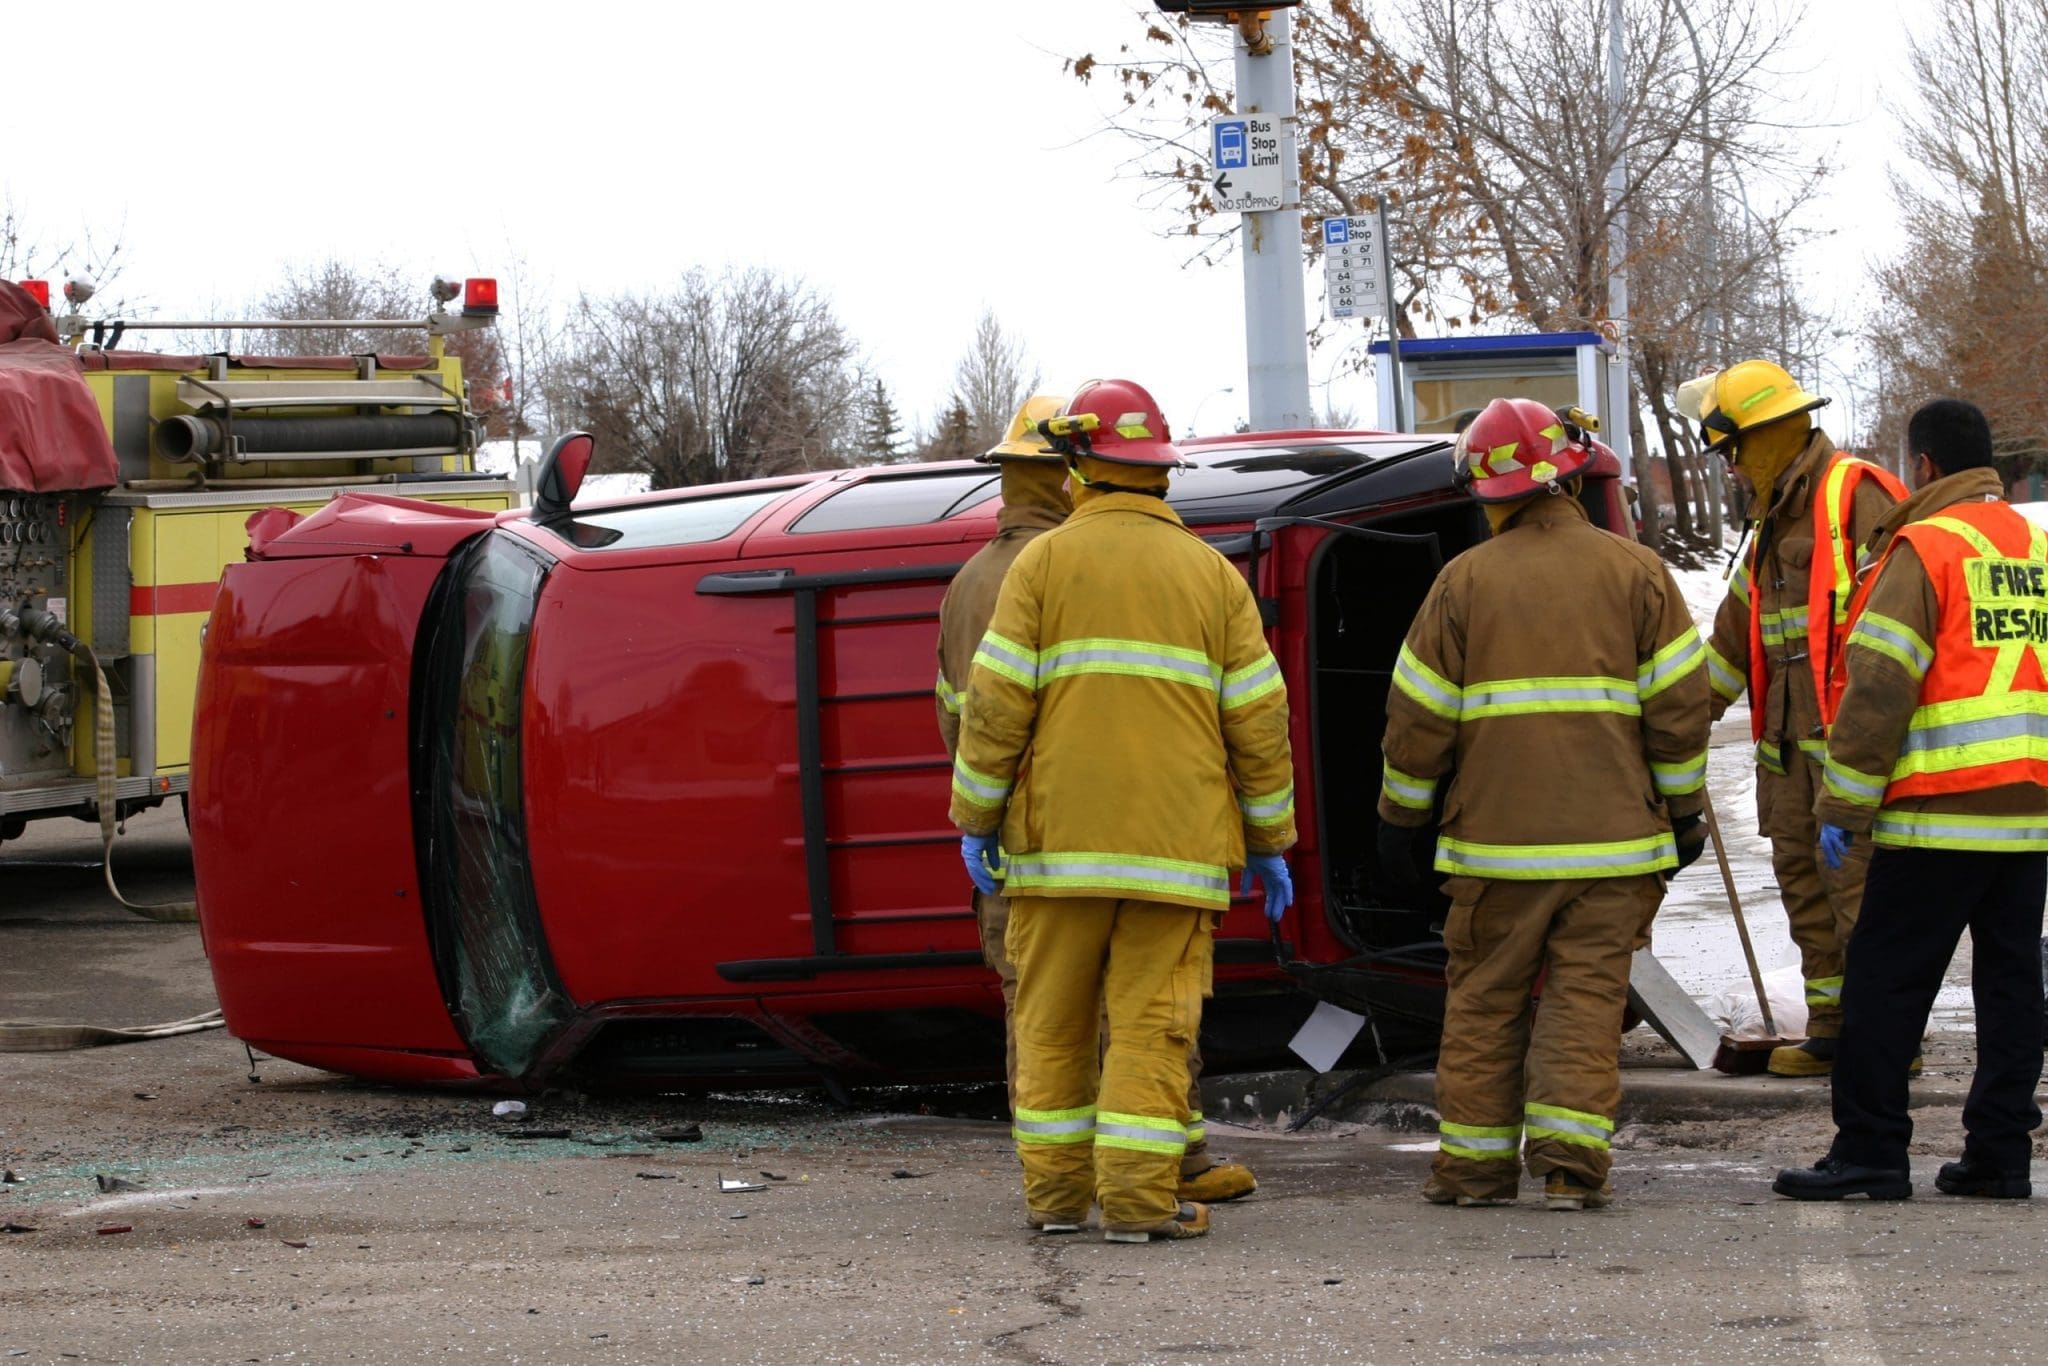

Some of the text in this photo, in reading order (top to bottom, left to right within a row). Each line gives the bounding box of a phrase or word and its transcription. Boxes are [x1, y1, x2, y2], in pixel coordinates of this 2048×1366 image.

[1250, 120, 1271, 133] Bus
[1251, 137, 1277, 152] Stop
[1252, 152, 1279, 167] Limit
[1219, 196, 1279, 210] NO STOPPING
[1347, 218, 1367, 228] Bus
[1348, 229, 1372, 240] Stop
[1341, 244, 1370, 255] 6 67
[1342, 257, 1371, 268] 8 71
[1337, 271, 1350, 281] 64
[1338, 285, 1351, 294] 65
[1339, 298, 1352, 306] 66
[1990, 564, 2045, 597] FIRE
